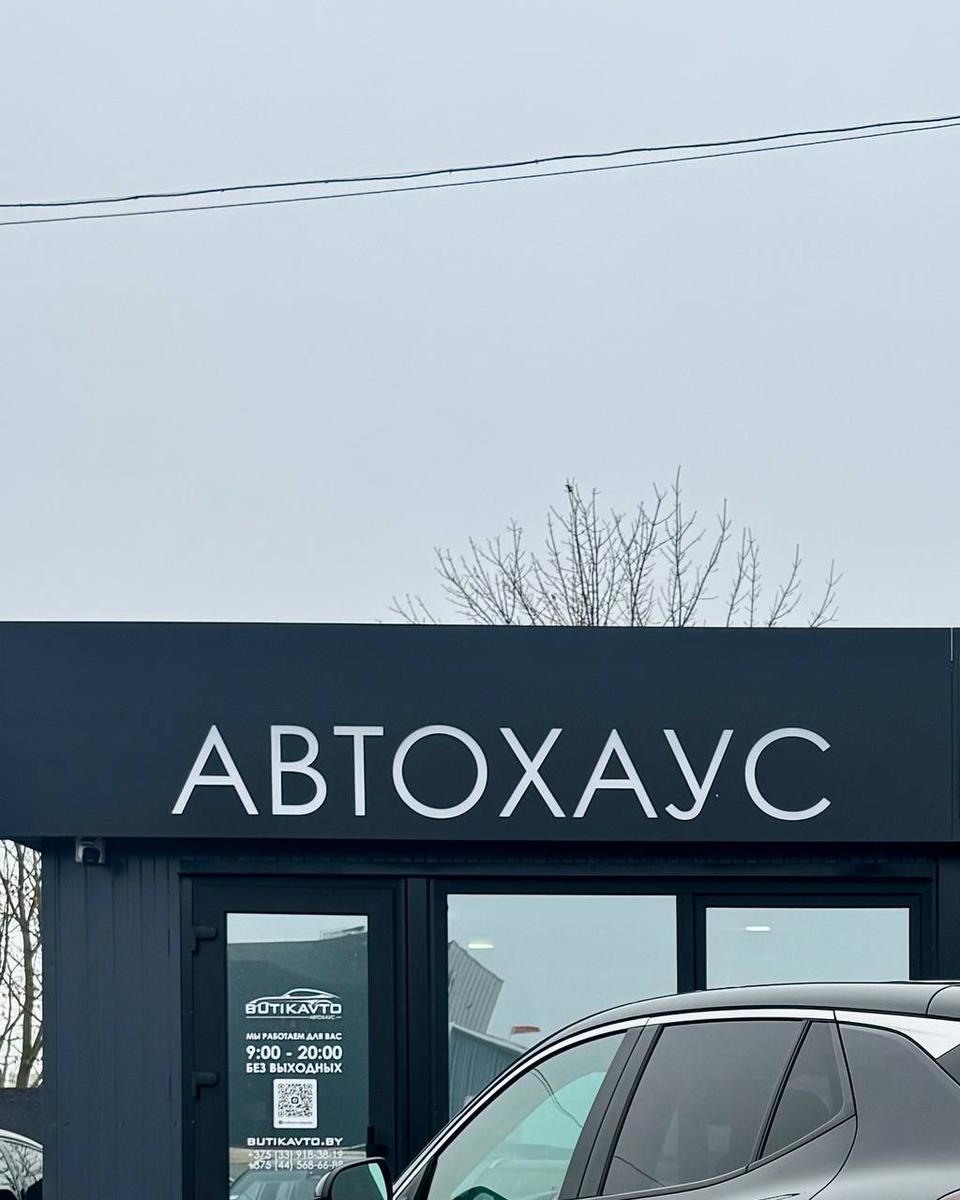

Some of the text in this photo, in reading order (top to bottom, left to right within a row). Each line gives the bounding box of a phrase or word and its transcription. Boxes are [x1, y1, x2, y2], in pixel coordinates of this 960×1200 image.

[172, 724, 831, 821] АВТОХАУС
[245, 1003, 342, 1015] BUTIKAVTO
[306, 1033, 324, 1041] ДЛЯ
[246, 1045, 281, 1060] 9:00
[297, 1045, 343, 1060] 20:00
[246, 1063, 342, 1074] БЕЗ ВЫХОДНЫХ
[247, 1137, 343, 1146] BUTIKAVTO.BY
[248, 1149, 343, 1161] +375 (33) 918-38-19
[275, 1160, 293, 1171] (44)
